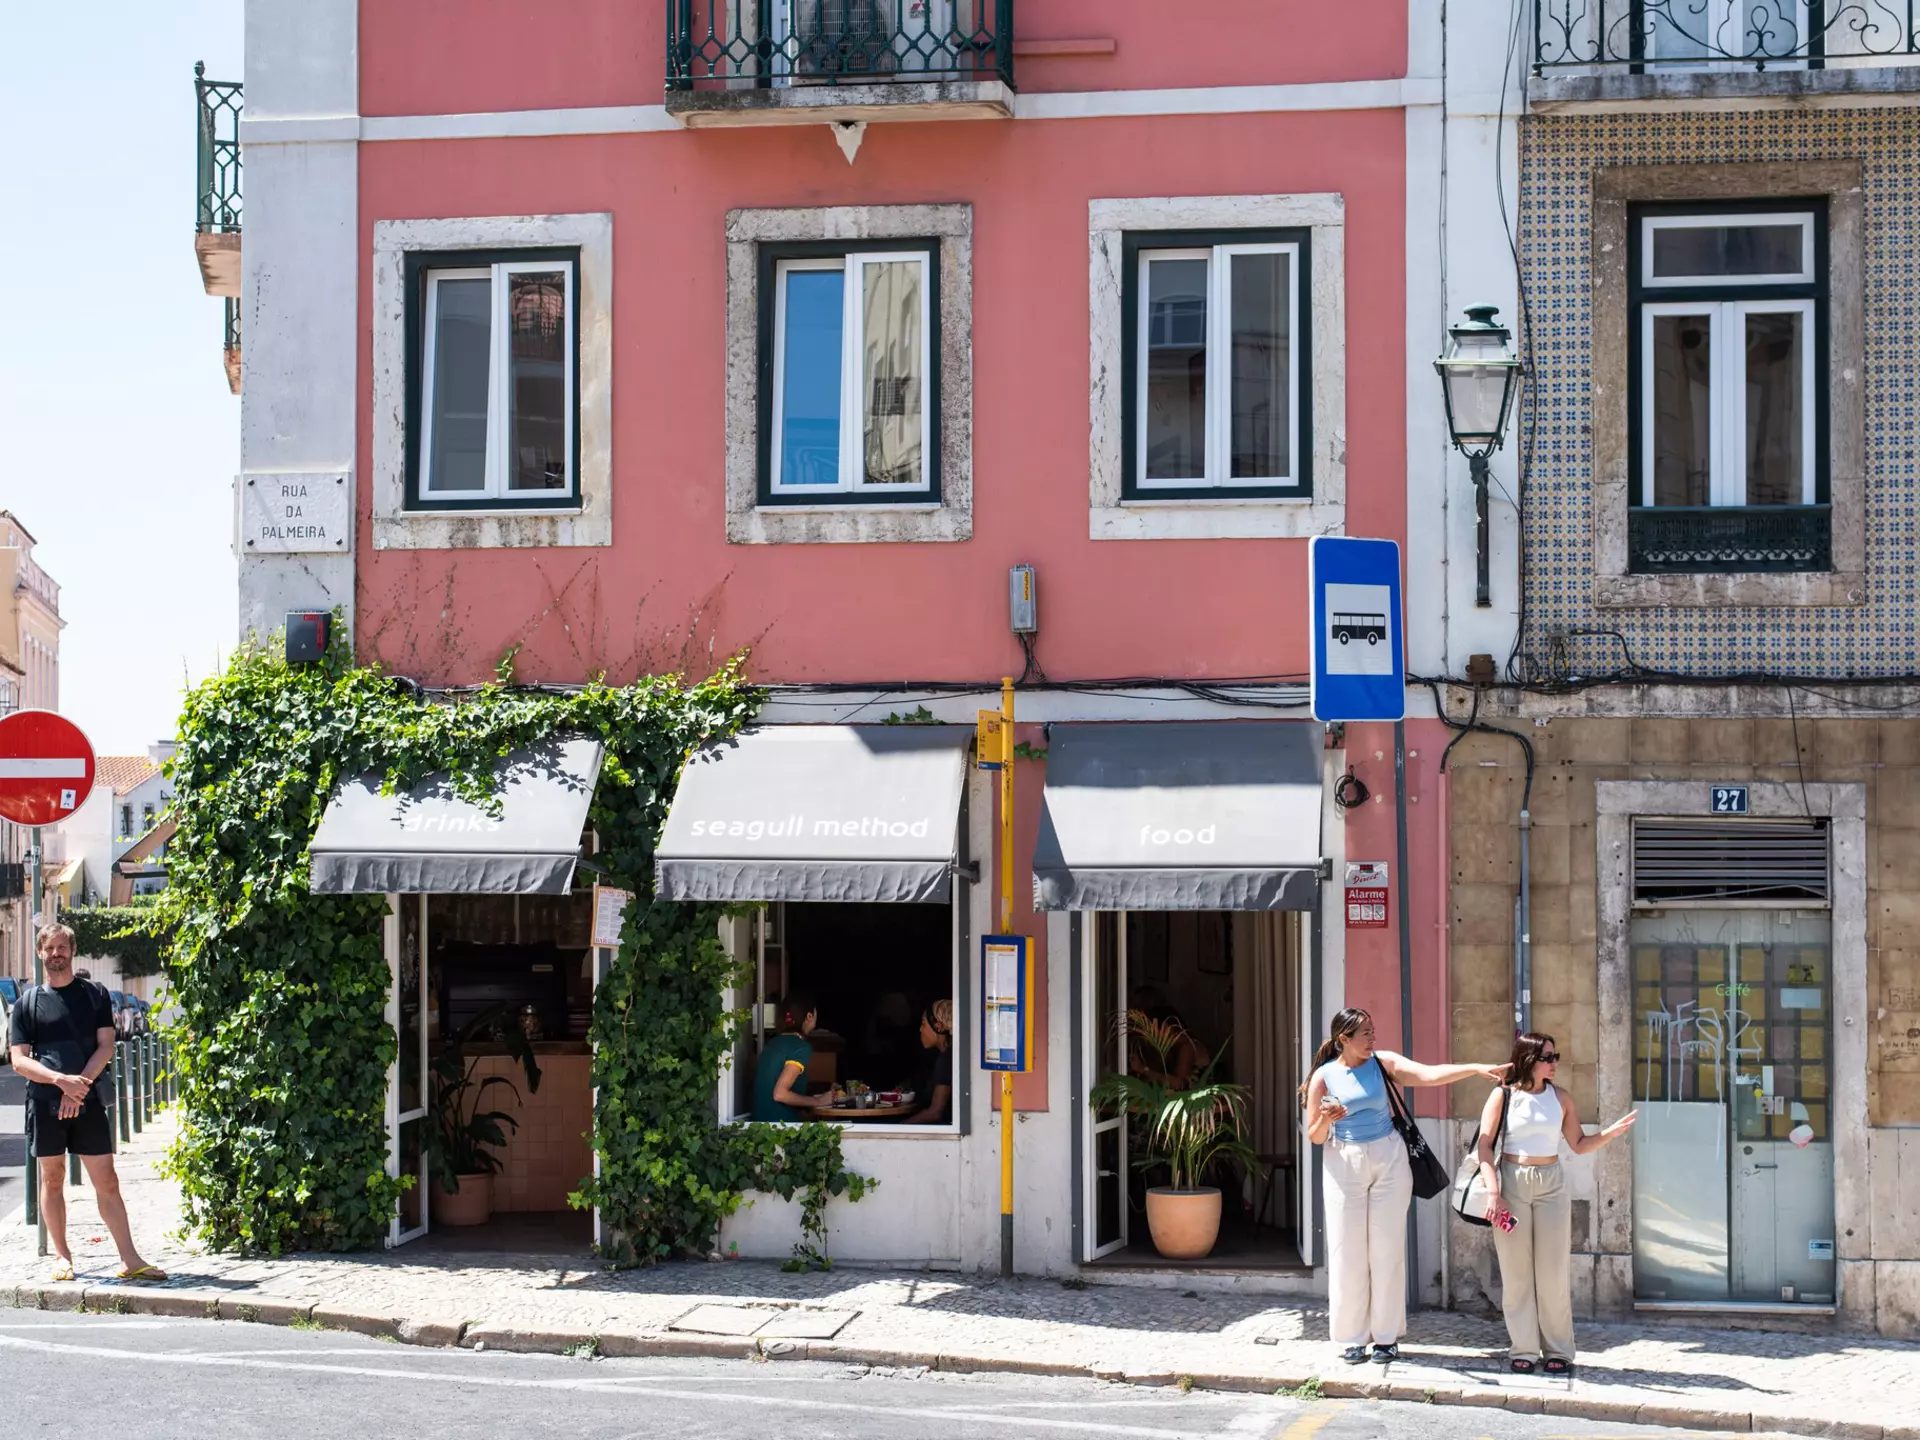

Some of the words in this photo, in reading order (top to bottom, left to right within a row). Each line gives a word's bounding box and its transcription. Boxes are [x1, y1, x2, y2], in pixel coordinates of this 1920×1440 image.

[281, 485, 307, 497] RUA
[286, 505, 302, 518] DA
[262, 526, 326, 539] PALMEIRA
[1717, 789, 1741, 811] 27
[403, 813, 501, 832] drinks
[689, 815, 803, 841] seagull
[812, 817, 929, 838] method
[1139, 823, 1216, 846] food
[1348, 889, 1385, 898] Alarme
